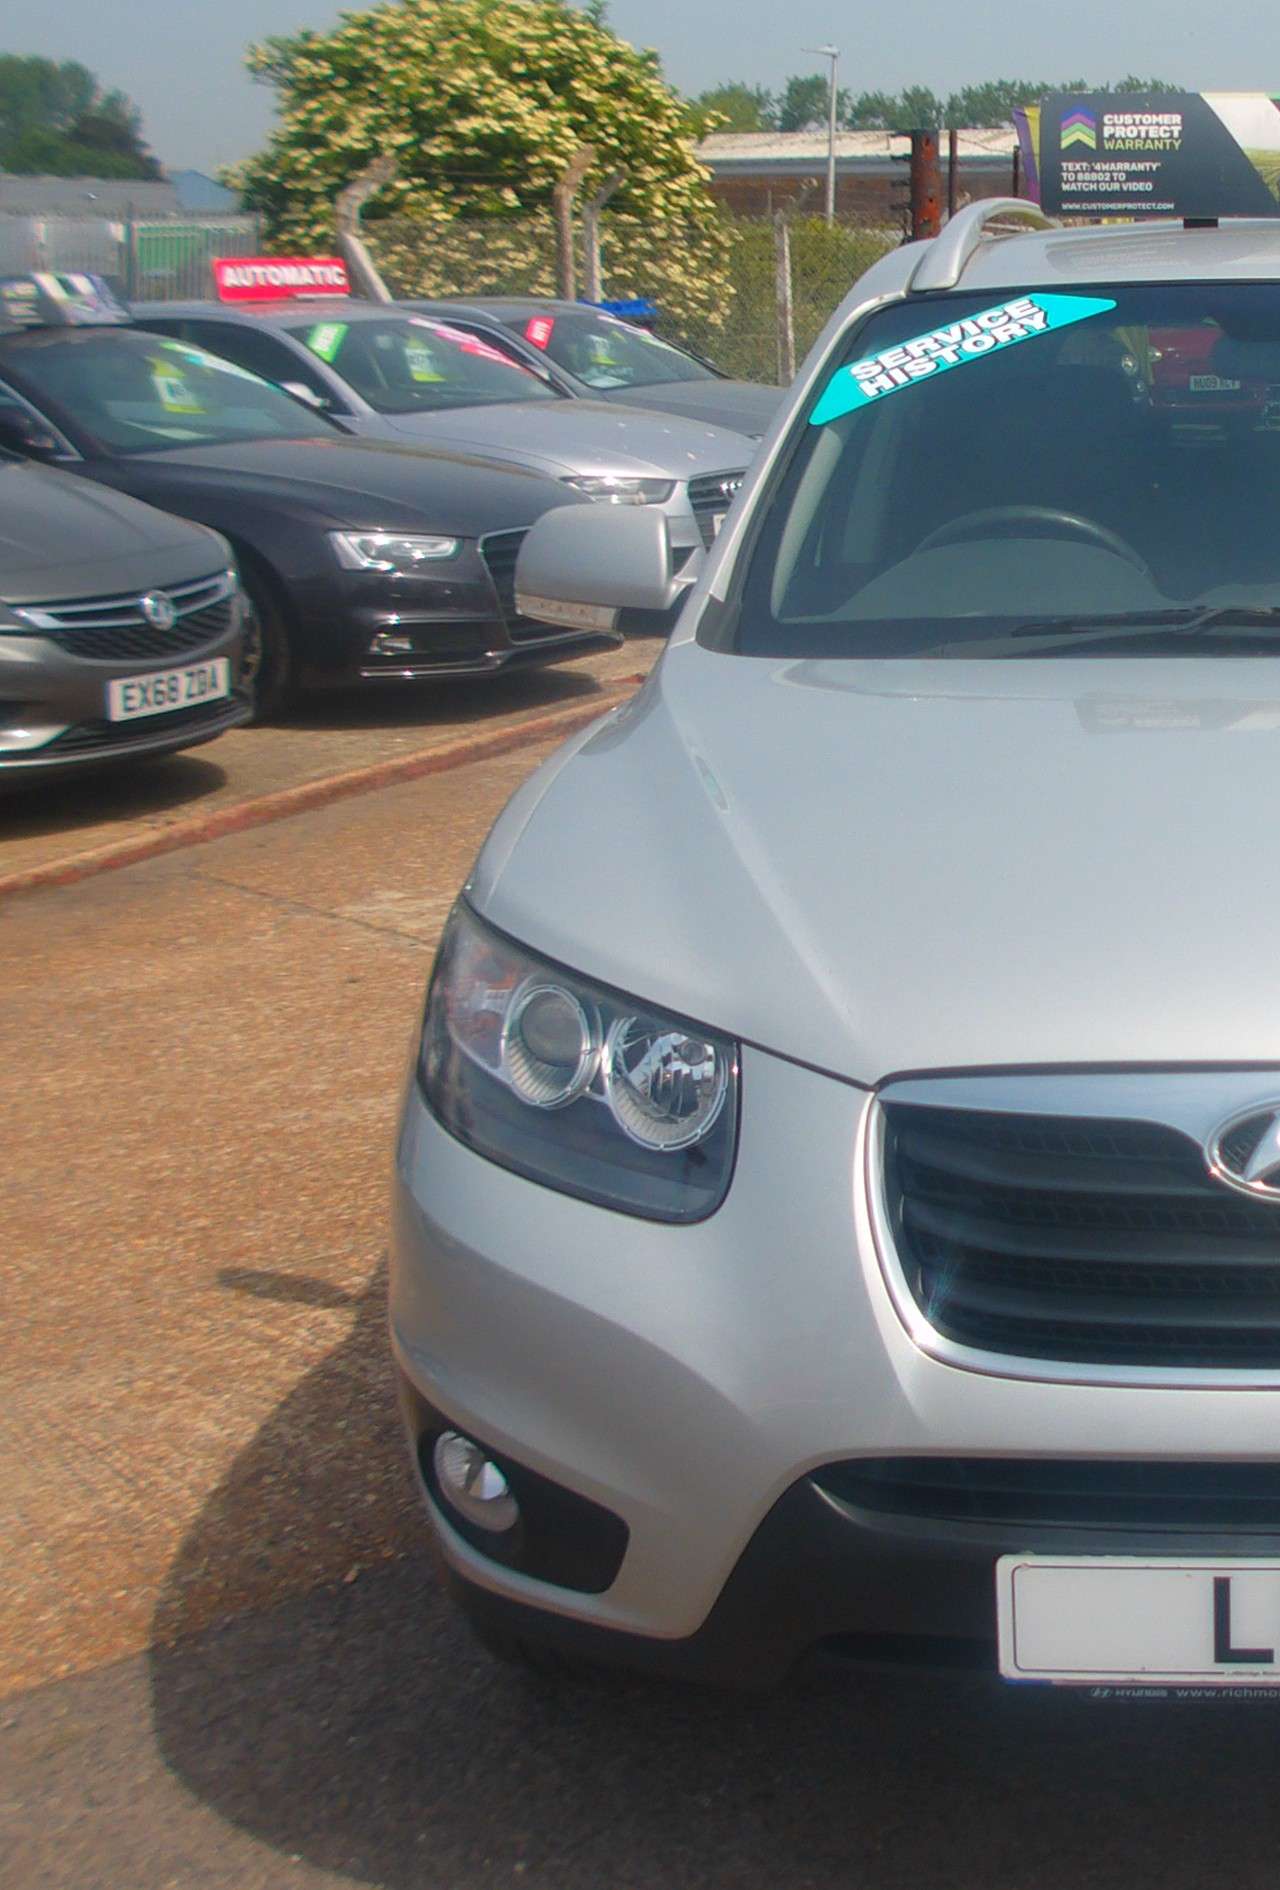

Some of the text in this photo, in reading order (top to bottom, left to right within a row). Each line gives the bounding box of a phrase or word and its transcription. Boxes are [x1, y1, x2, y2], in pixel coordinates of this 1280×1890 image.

[1103, 113, 1181, 125] CUSTOMER
[1103, 125, 1182, 138] PROTECT
[1103, 138, 1181, 150] WARRANTY
[1061, 162, 1090, 172] TEXT:
[1061, 172, 1075, 181] TO
[1112, 172, 1126, 181] TO
[1061, 182, 1153, 191] WATCH OUR VIDEO
[223, 264, 347, 287] AUTOMATIC
[850, 298, 1043, 381] SERVICE
[856, 311, 1050, 399] HISTORY
[122, 672, 179, 712] EX68
